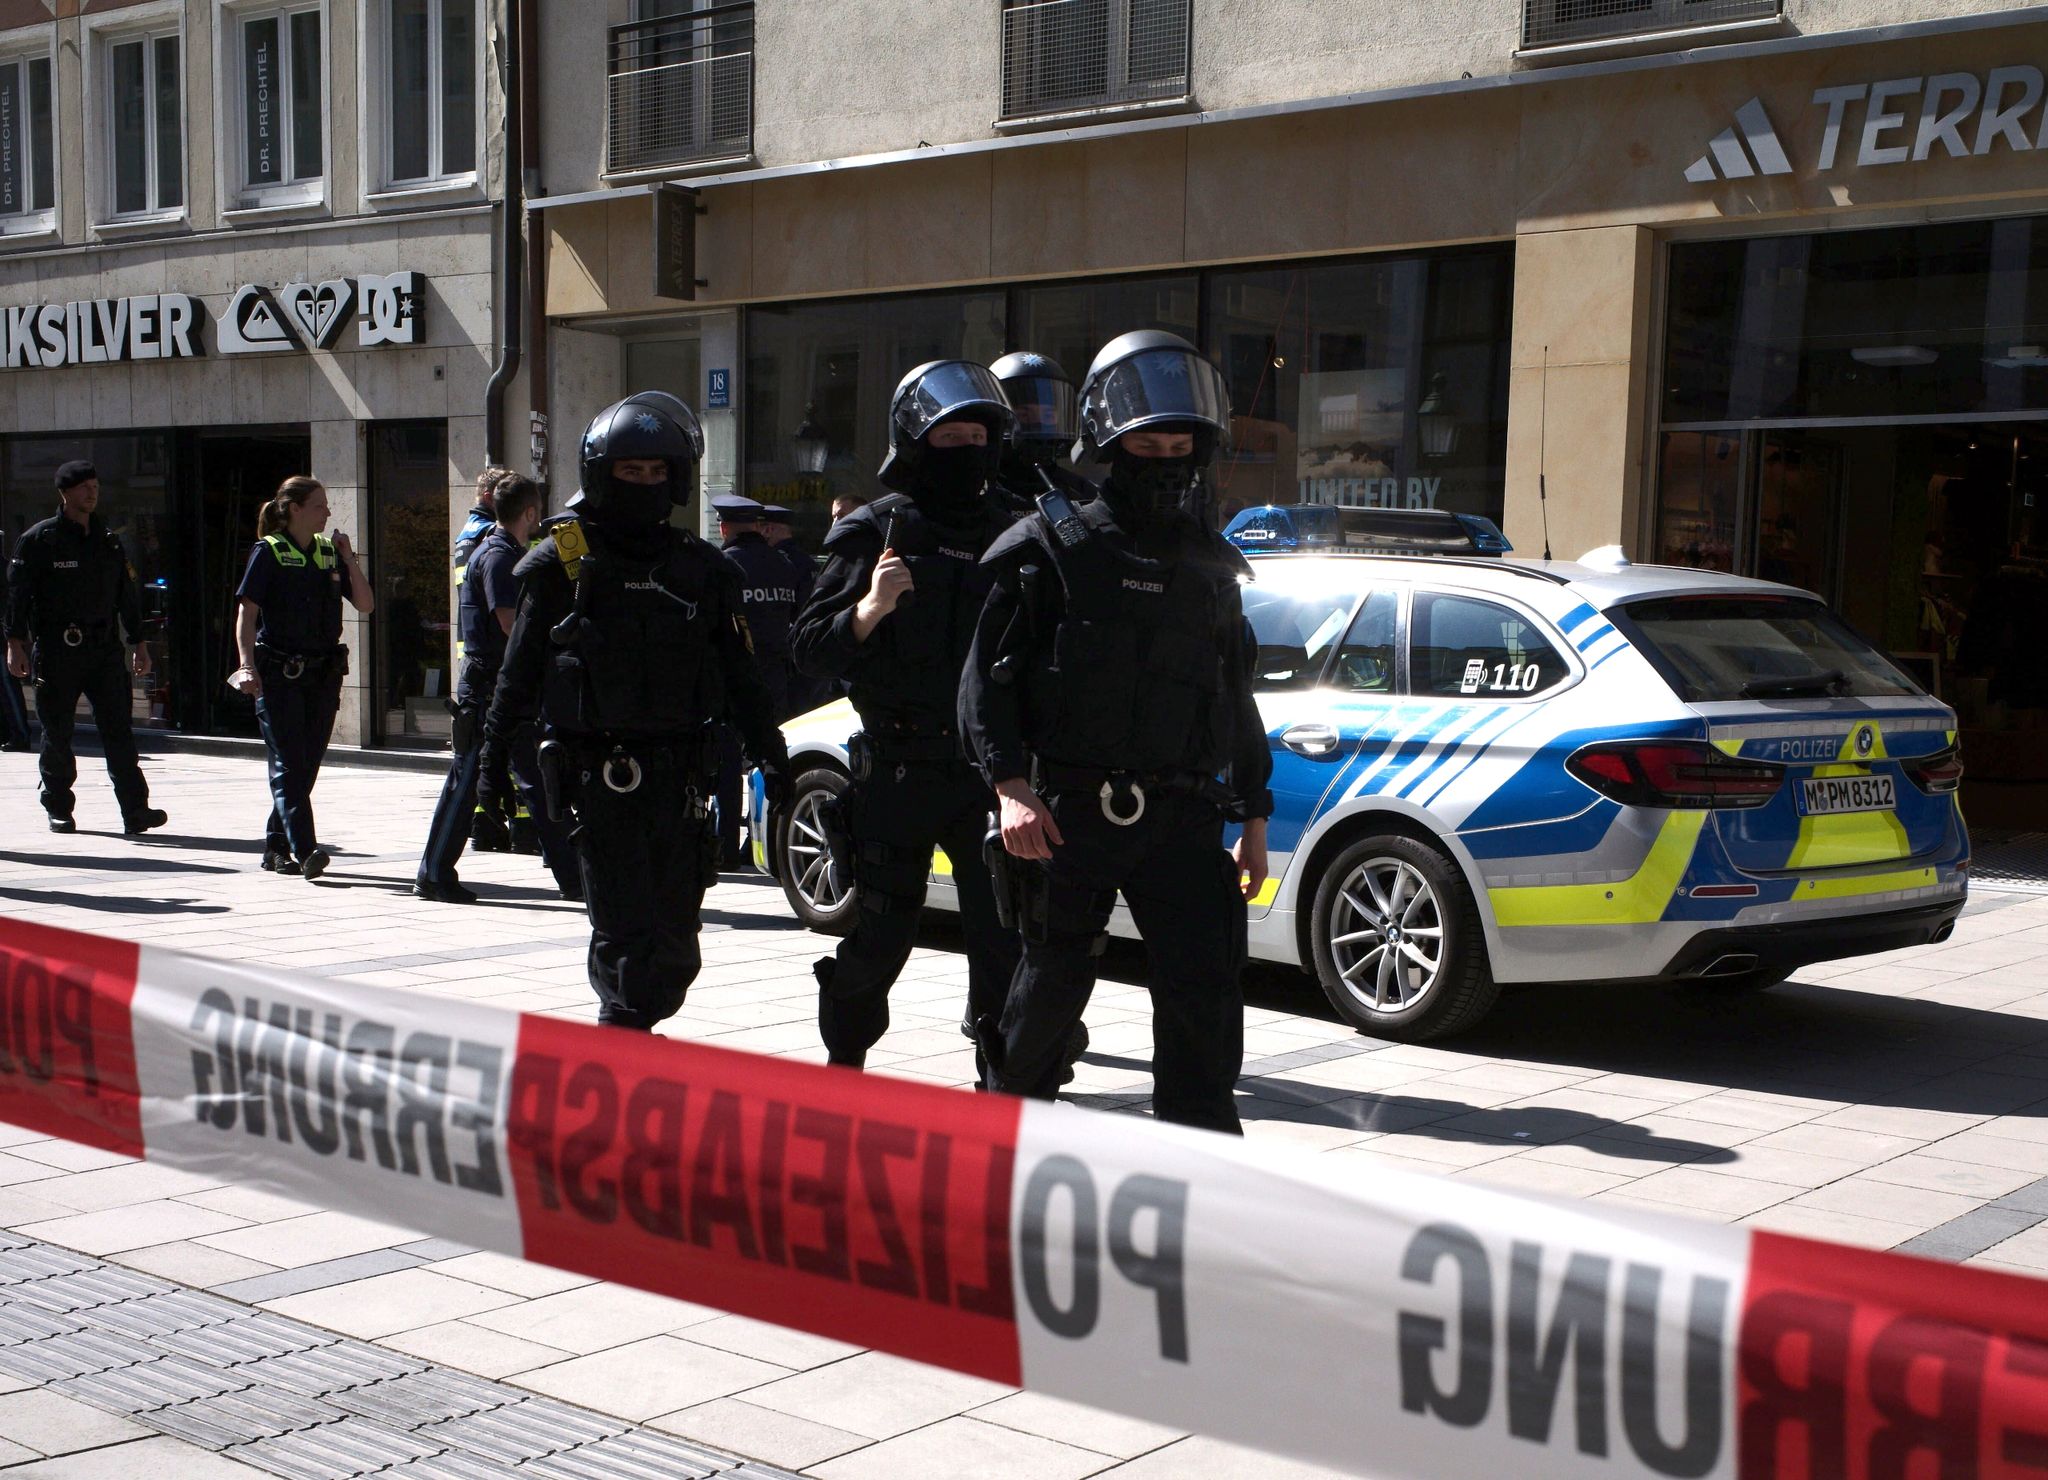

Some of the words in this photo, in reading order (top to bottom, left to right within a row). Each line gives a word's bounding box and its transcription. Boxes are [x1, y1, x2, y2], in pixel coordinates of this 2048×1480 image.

[257, 41, 269, 138] PRECHTEL
[1, 85, 12, 173] PRECHTEL
[1811, 65, 2048, 170] TERR
[260, 143, 270, 173] DR.
[4, 177, 12, 204] DR.
[713, 372, 725, 391] 18
[1299, 477, 1397, 507] UNITED
[1406, 476, 1441, 509] BY
[53, 560, 79, 569] POLIZEI
[938, 546, 974, 561] POLIZEI
[624, 582, 661, 590] POLIZE
[742, 587, 796, 603] POLIZEI
[1122, 578, 1164, 593] POLIZEI
[1489, 663, 1540, 691] 110
[1780, 739, 1837, 759] POLIZEI
[1805, 783, 1819, 810] M
[1827, 781, 1851, 809] PM
[1853, 779, 1893, 807] 8312
